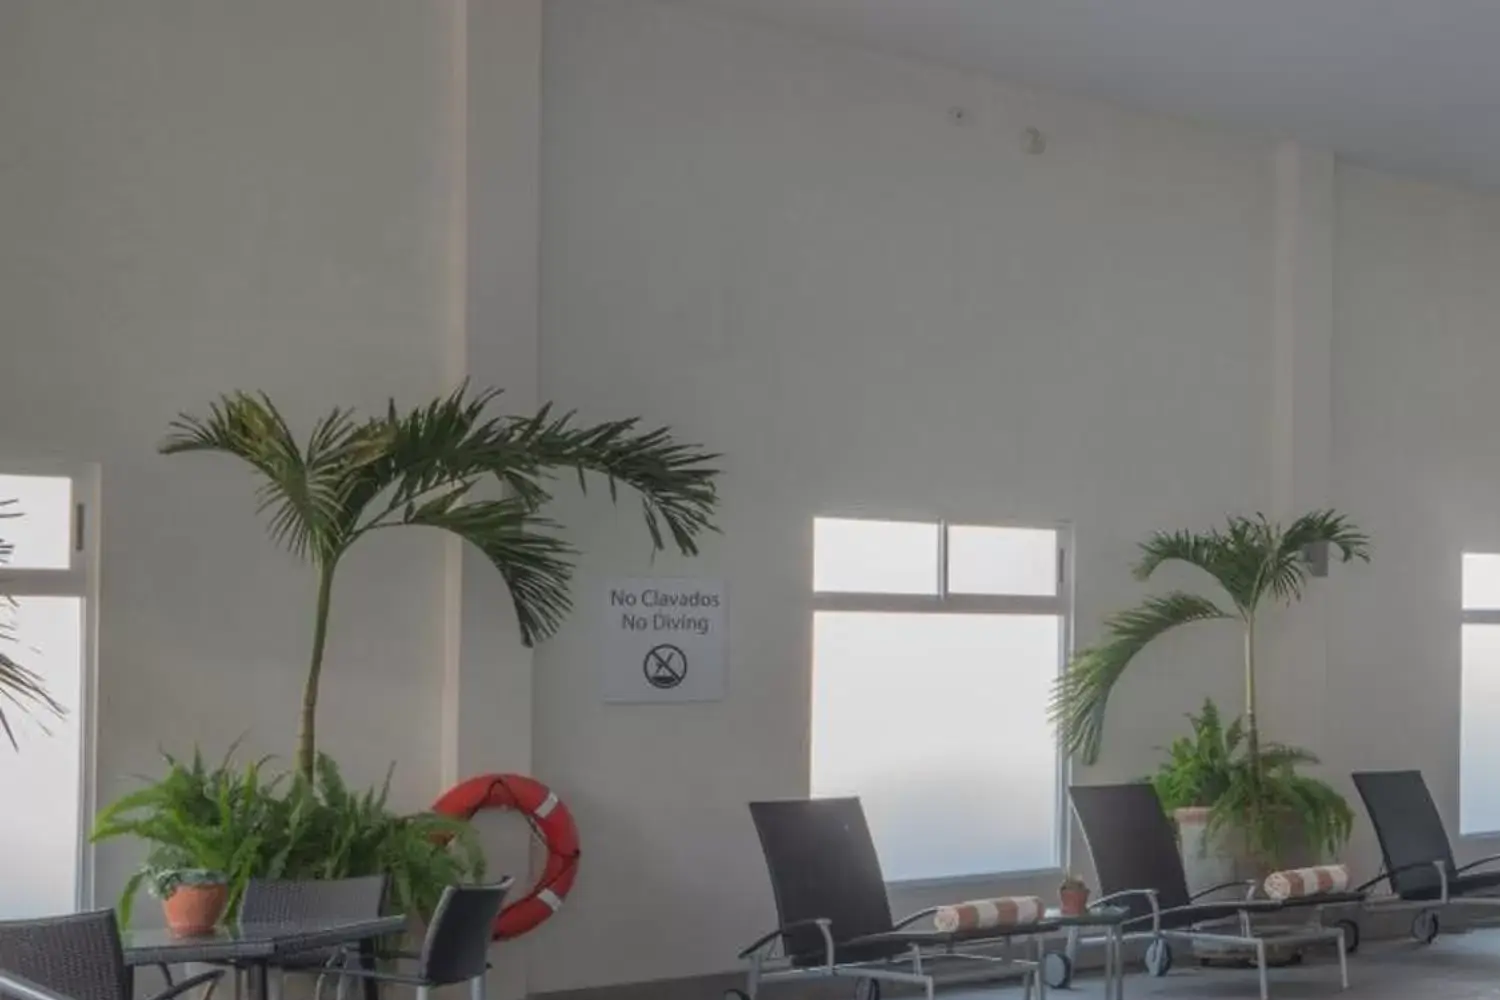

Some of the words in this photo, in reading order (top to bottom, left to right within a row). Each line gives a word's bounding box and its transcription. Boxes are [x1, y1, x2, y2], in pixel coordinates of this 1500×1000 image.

[611, 589, 637, 607] No
[641, 588, 720, 607] Clavados
[622, 613, 648, 631] No
[653, 613, 709, 635] Diving
